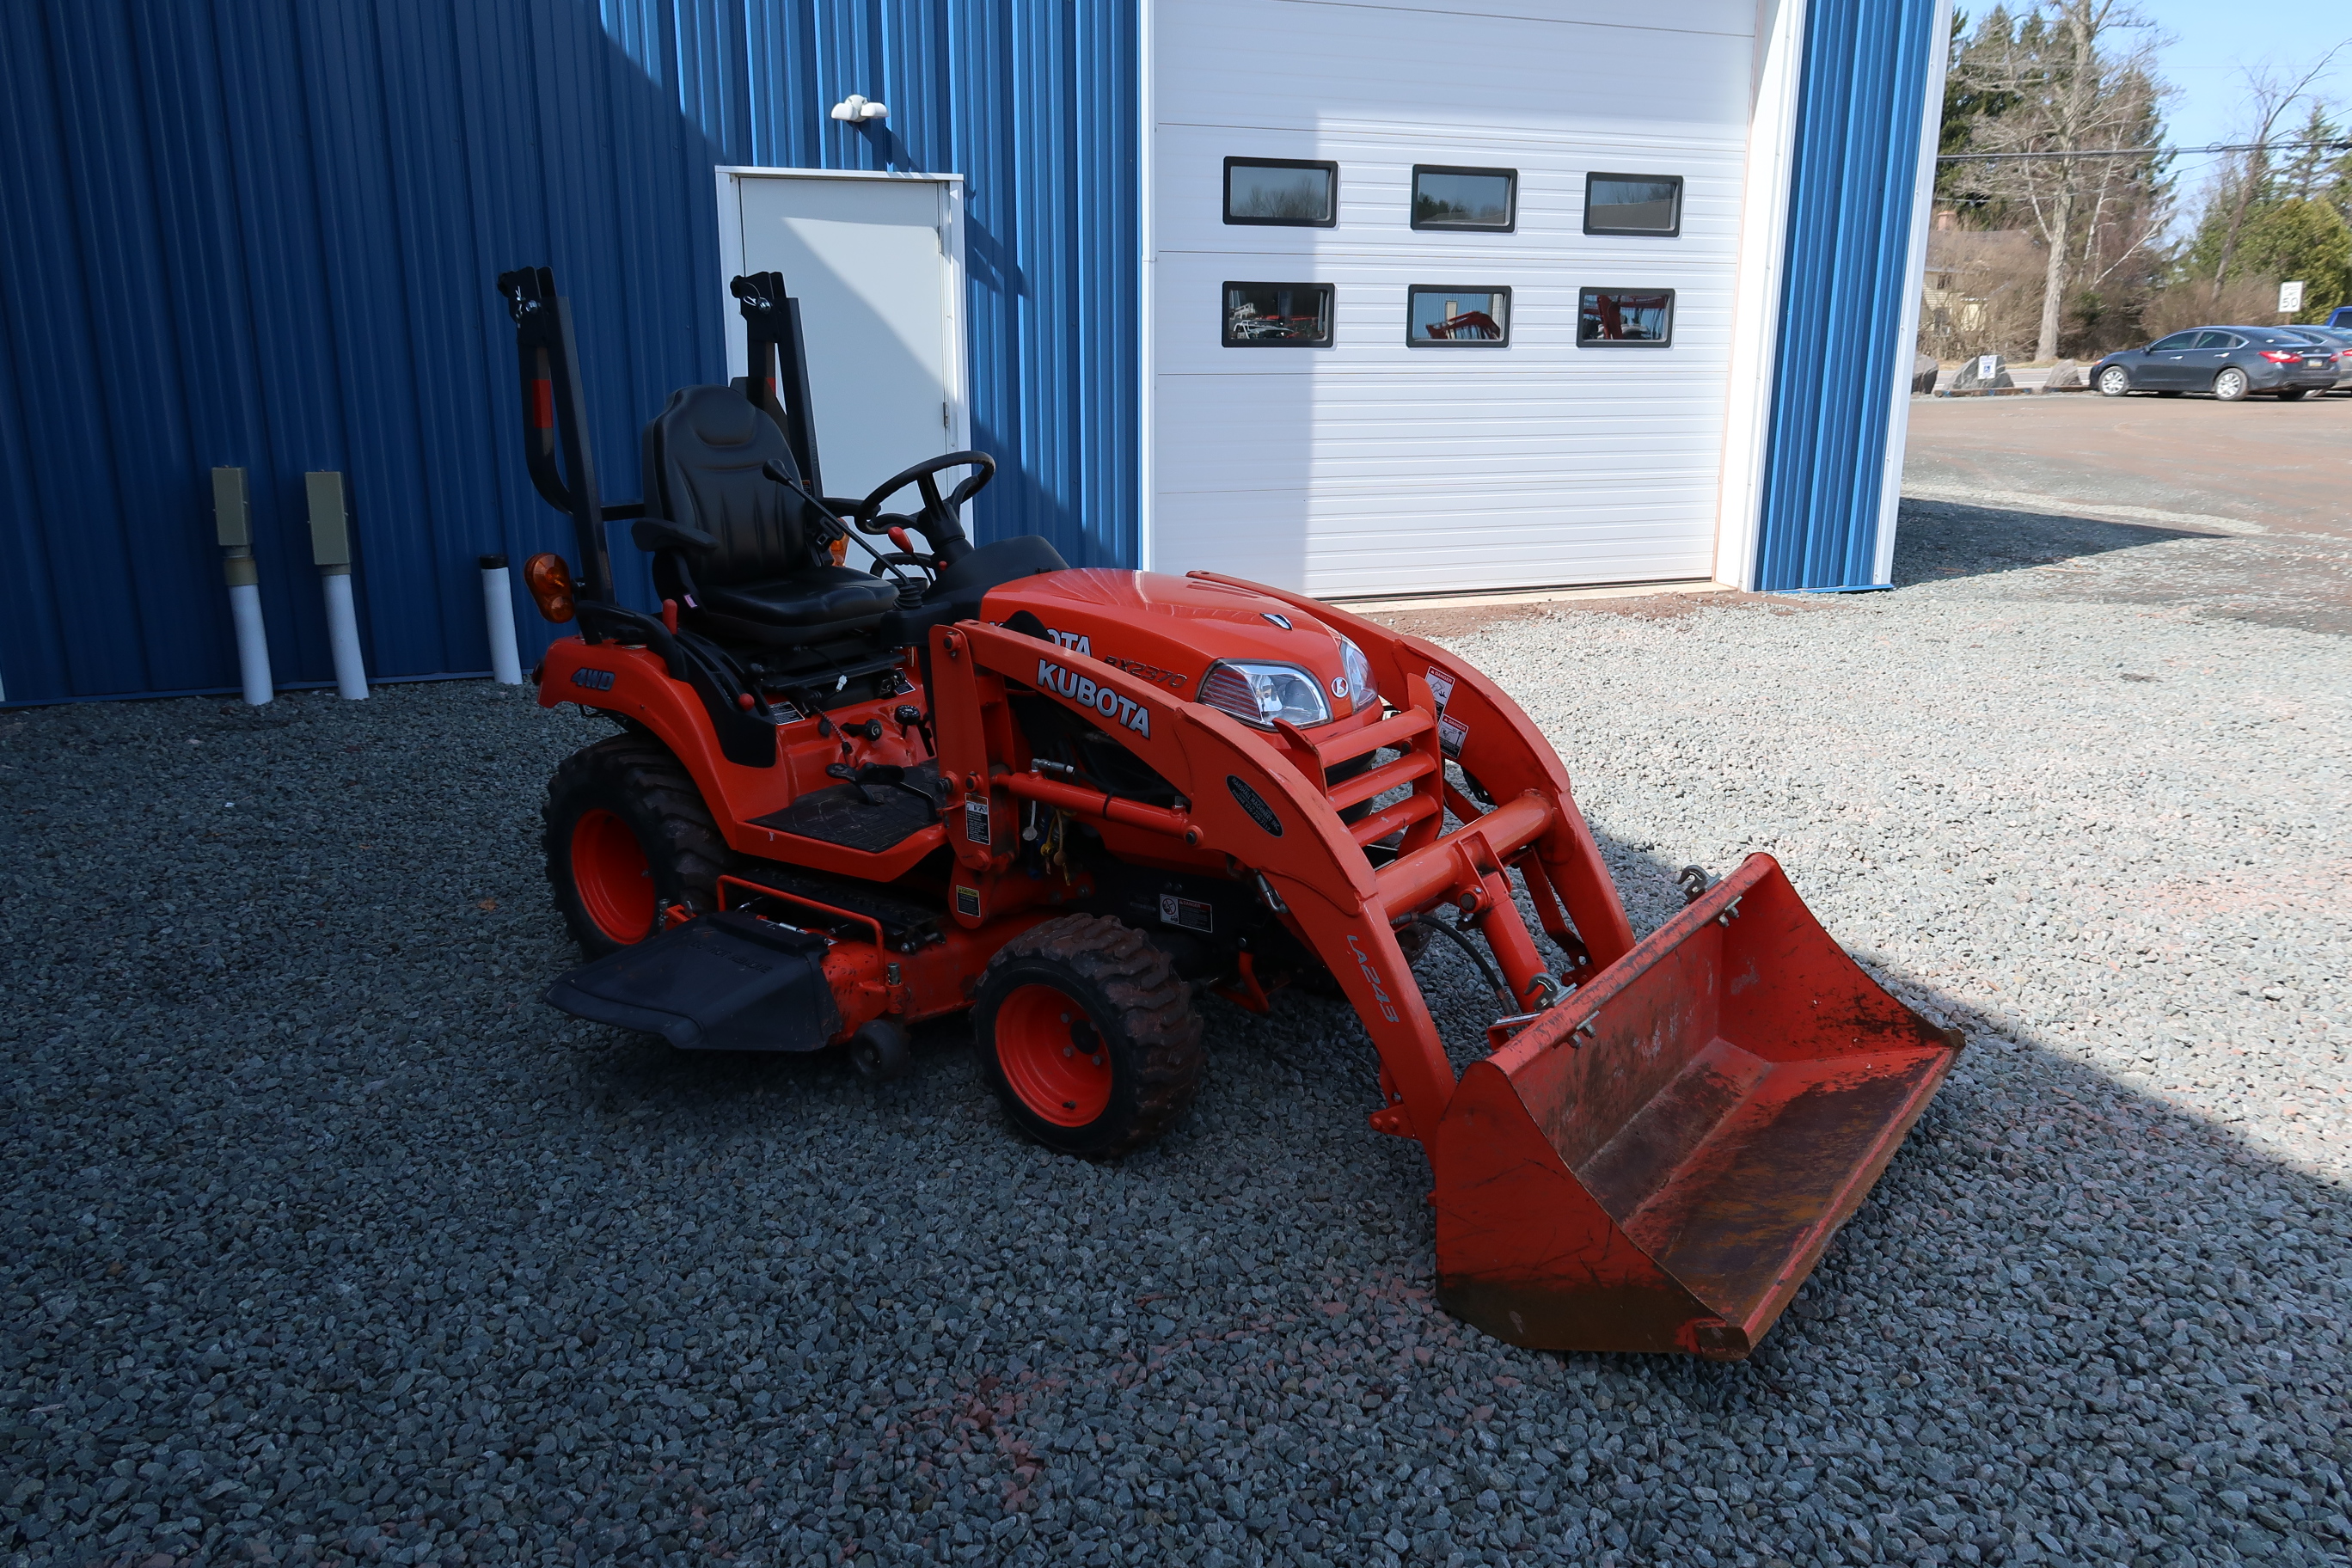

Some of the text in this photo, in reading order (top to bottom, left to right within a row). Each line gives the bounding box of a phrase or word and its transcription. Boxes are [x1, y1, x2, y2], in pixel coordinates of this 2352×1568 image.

[2281, 297, 2298, 309] 50
[571, 667, 616, 691] 4WD
[1434, 671, 1453, 684] DANGER
[1037, 658, 1150, 739] KUBOTA
[1448, 719, 1467, 731] DANGER
[1231, 788, 1245, 804] PHONE
[1231, 777, 1252, 799] MARSHALL
[1250, 797, 1272, 821] MACHINERY
[1184, 900, 1201, 909] DANGER
[1347, 935, 1400, 1023] LA243
